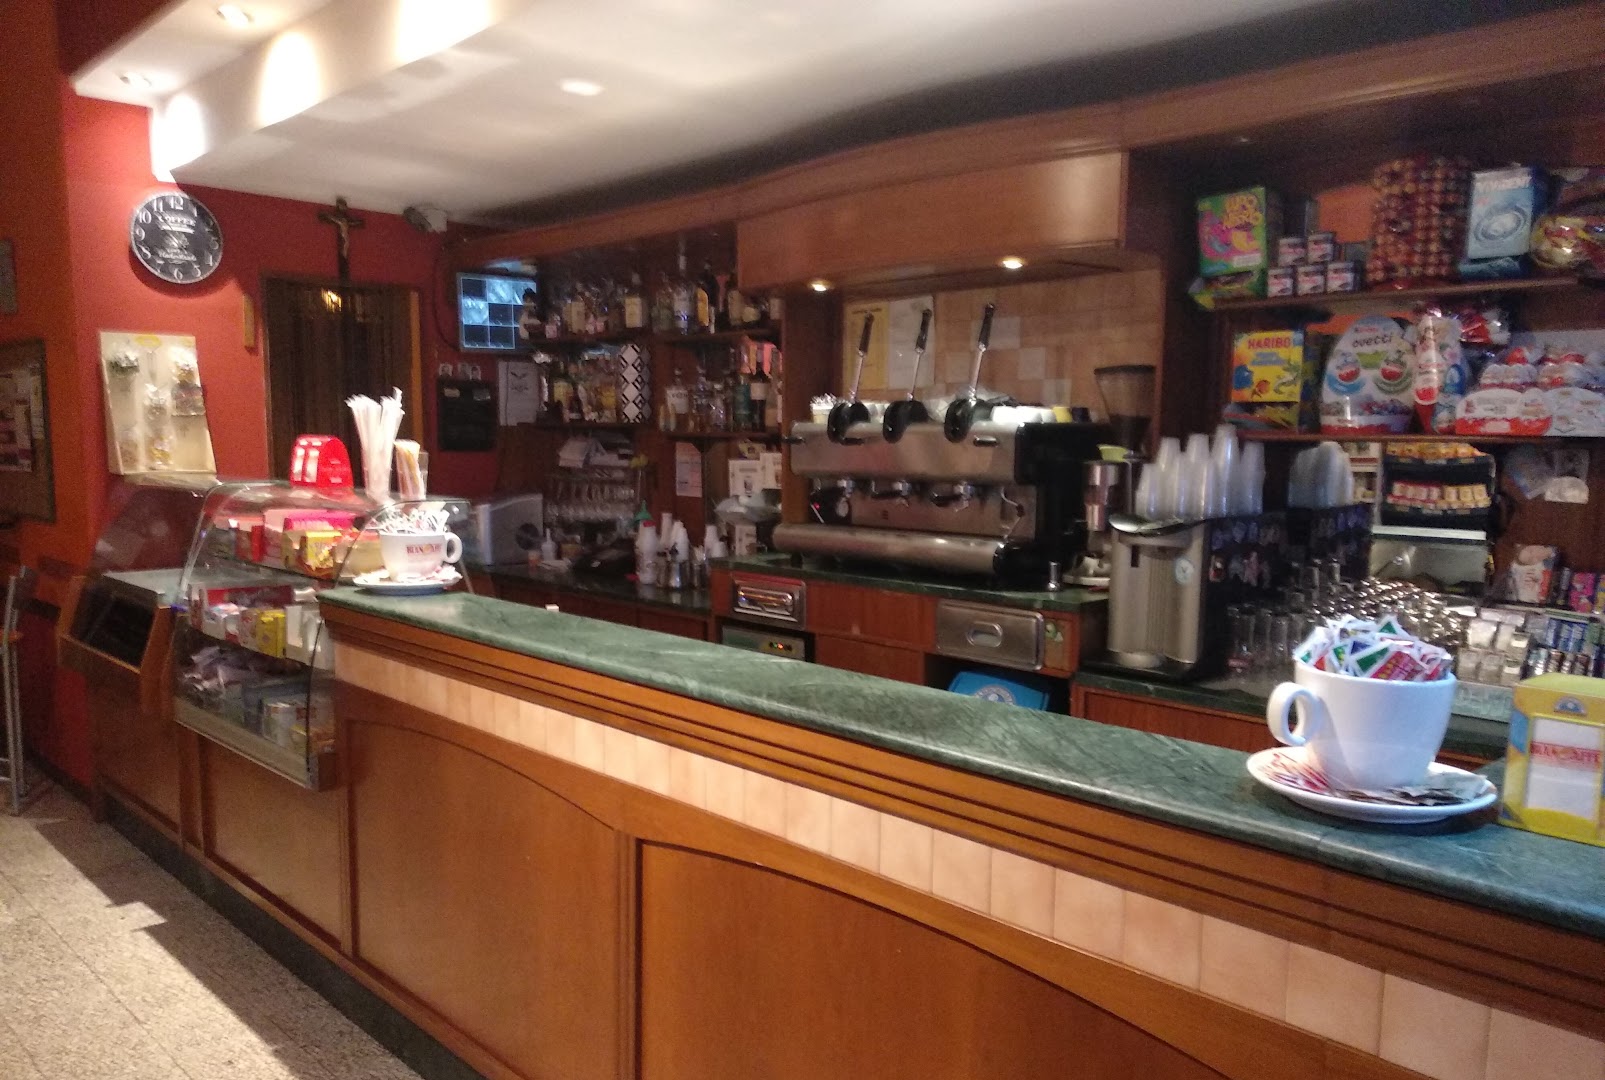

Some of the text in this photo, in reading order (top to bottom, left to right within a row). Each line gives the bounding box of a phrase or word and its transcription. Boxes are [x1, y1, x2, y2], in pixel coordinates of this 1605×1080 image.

[153, 198, 164, 212] 11
[169, 196, 184, 210] 12
[139, 209, 152, 224] 10
[136, 228, 146, 241] 9
[173, 267, 184, 280] 6
[1247, 337, 1291, 349] HARIBO
